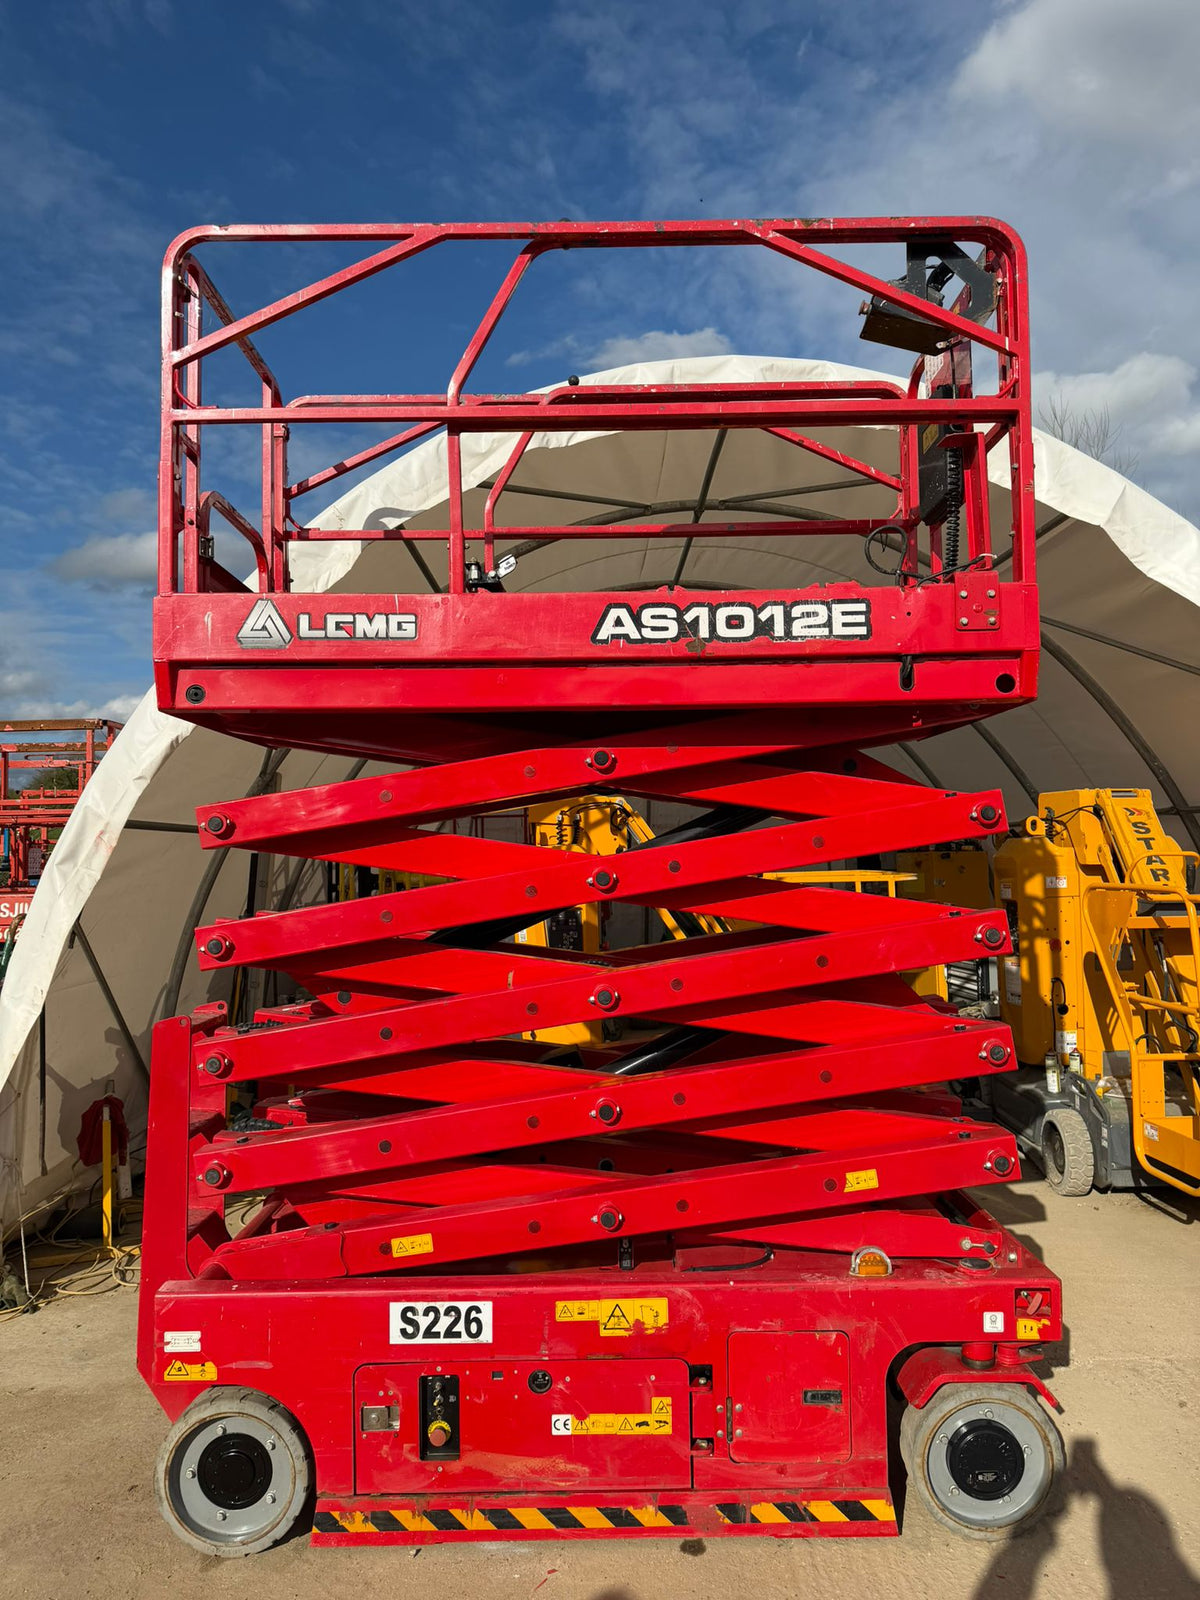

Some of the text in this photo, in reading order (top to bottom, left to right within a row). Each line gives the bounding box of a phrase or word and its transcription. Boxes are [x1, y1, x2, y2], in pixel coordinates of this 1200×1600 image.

[298, 613, 417, 639] LGMG
[595, 602, 868, 641] AS1012E
[399, 1305, 483, 1340] S226
